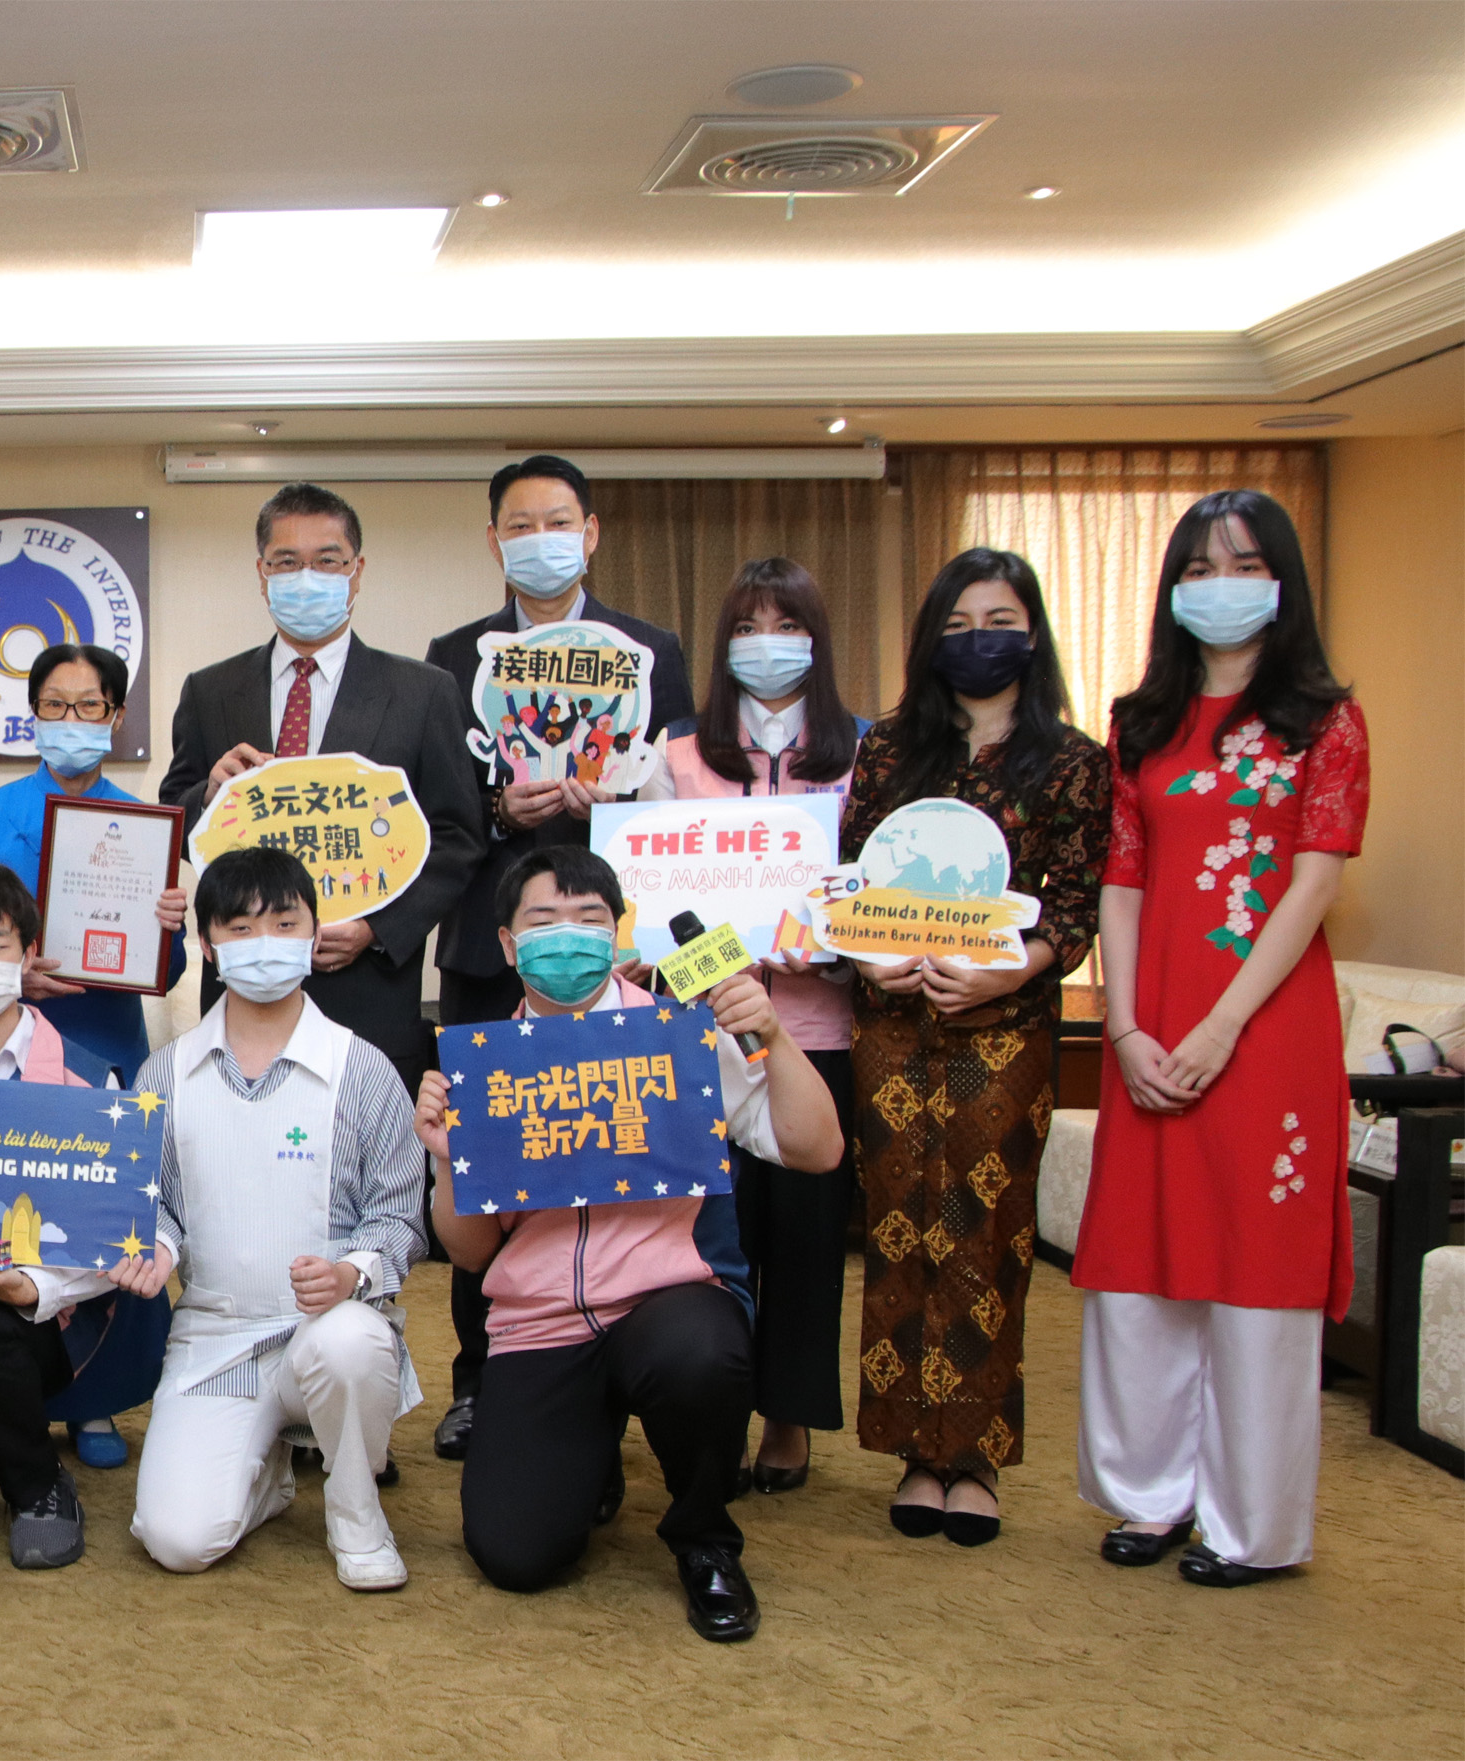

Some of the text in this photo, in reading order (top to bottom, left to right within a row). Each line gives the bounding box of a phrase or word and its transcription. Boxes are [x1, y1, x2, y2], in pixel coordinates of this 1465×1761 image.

[23, 527, 77, 555] THE
[82, 556, 132, 662] INTERIO
[492, 645, 641, 690] 接軌國際
[246, 782, 368, 822] 多元文化
[626, 818, 802, 862] THẾ HỆ 2
[616, 865, 662, 891] ỨC
[667, 866, 752, 895] MẠNH
[852, 900, 992, 927] Pemuda Pelopor
[825, 922, 1009, 951] Kebijakan Baru Arah Selatan
[669, 938, 745, 993] 劉德曜
[486, 1053, 678, 1118] 新光閃閃
[3, 1128, 27, 1148] tài
[55, 1133, 111, 1159] phong
[520, 1098, 650, 1160] 新力量
[22, 1160, 68, 1180] NAM
[73, 1160, 118, 1184] MỚI
